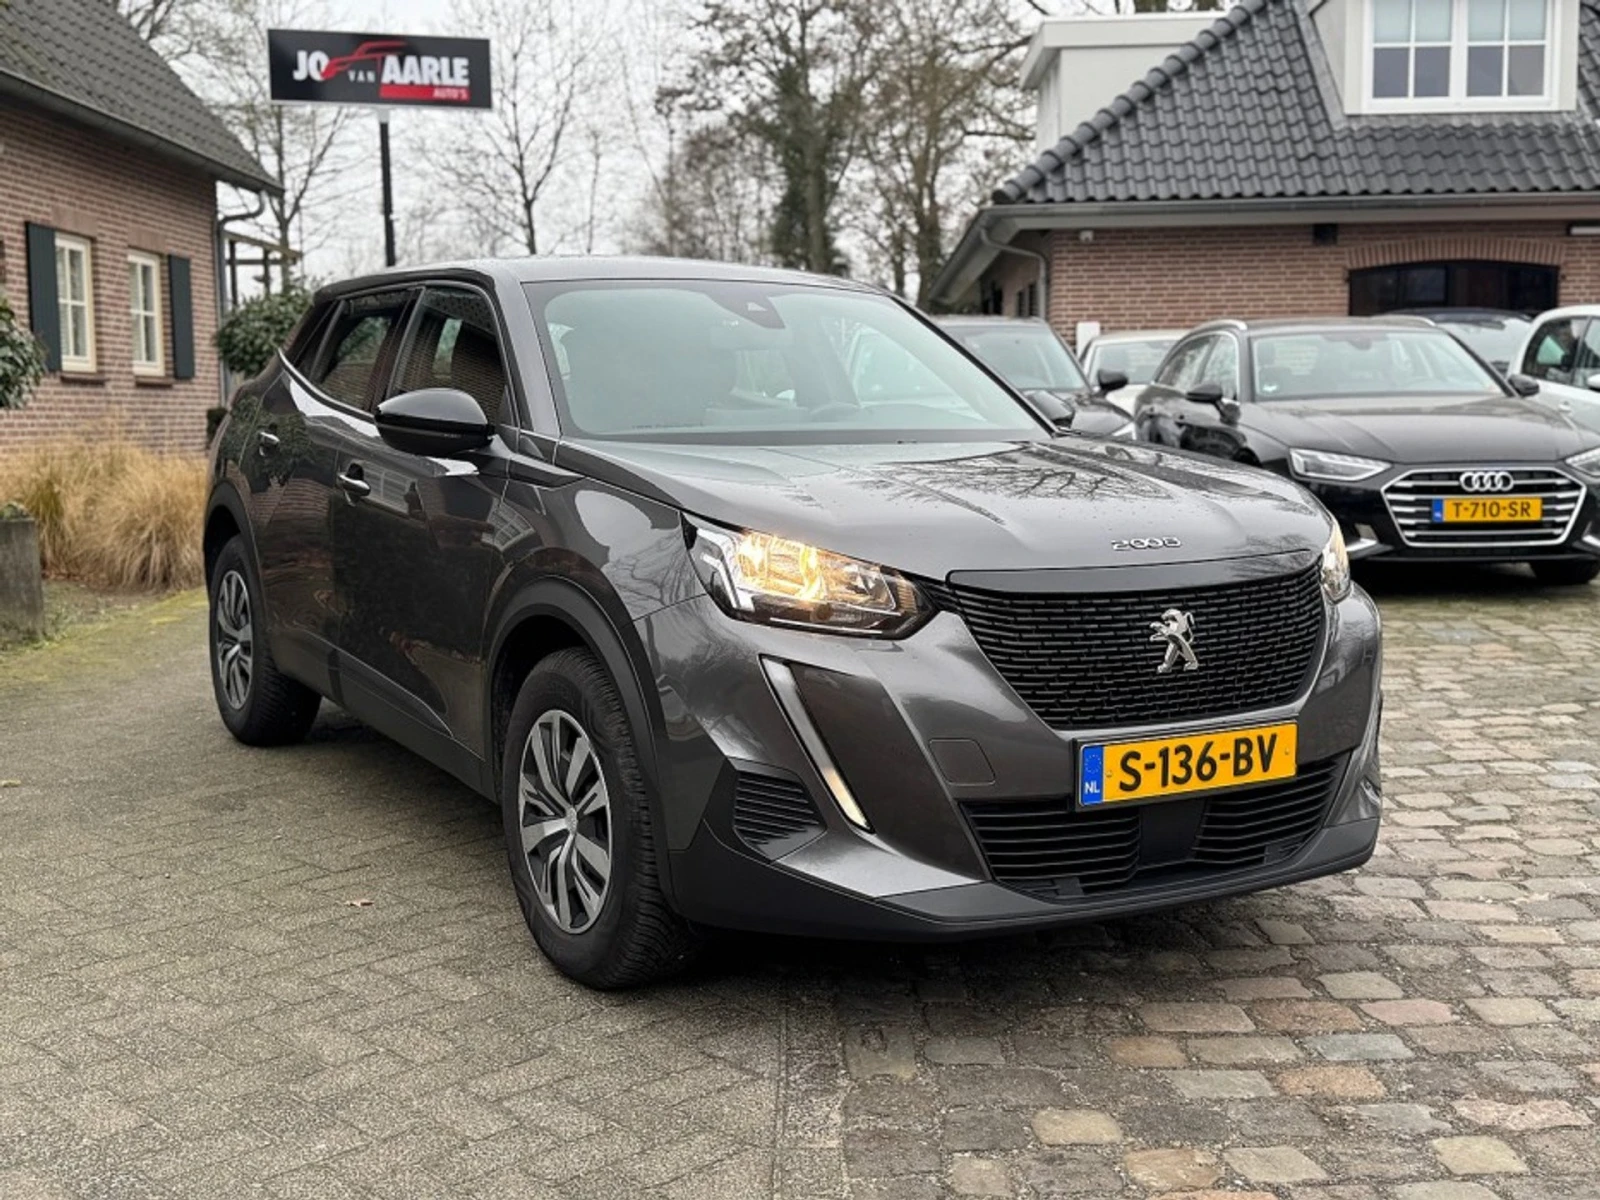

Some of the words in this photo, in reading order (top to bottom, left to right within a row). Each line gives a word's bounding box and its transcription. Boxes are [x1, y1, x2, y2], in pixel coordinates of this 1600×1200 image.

[293, 50, 329, 81] JO
[348, 70, 375, 82] VAN
[381, 55, 470, 86] AARLE
[1452, 501, 1531, 518] T-710-SR
[1119, 733, 1278, 792] S-136-BV
[1084, 780, 1100, 794] NL
